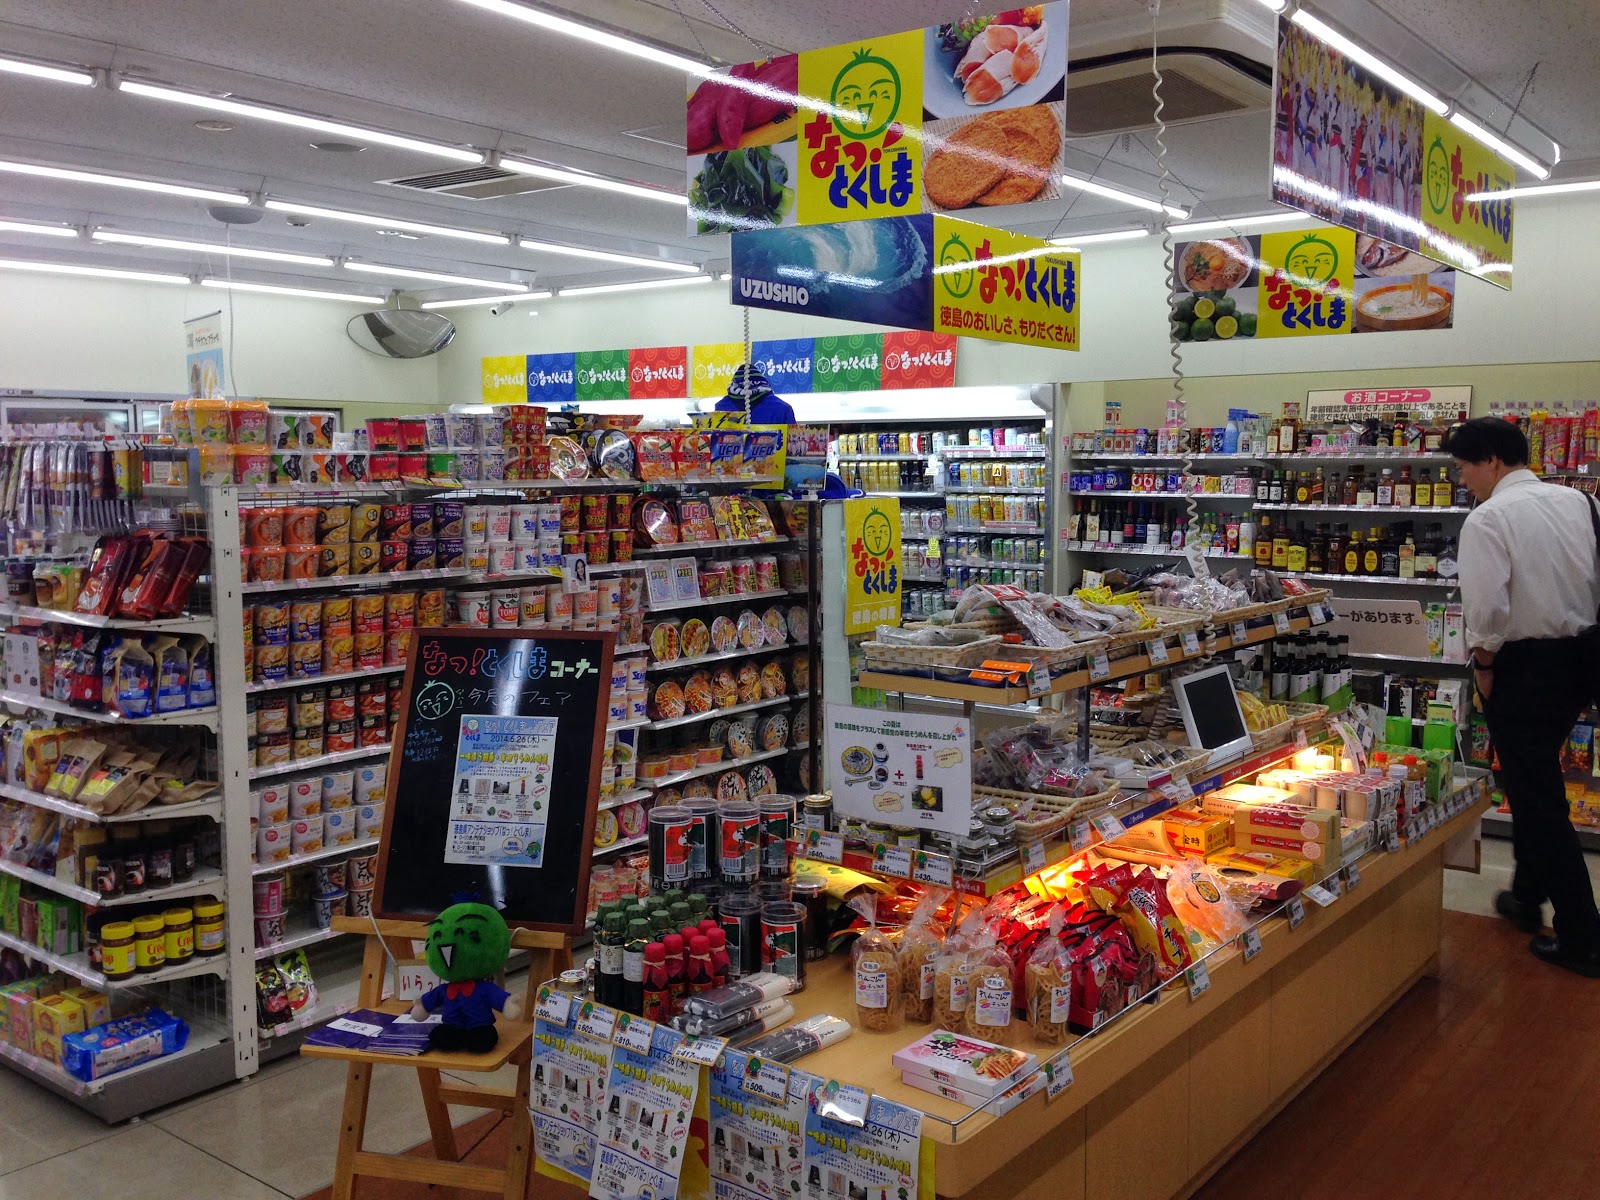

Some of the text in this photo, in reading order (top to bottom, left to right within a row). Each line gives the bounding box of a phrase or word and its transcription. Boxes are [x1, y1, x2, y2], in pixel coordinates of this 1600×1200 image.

[828, 152, 914, 210] とくしま
[740, 277, 809, 306] UZUSHIO
[1282, 296, 1346, 330] とくしま
[1351, 391, 1424, 403] お酒コーナー
[863, 564, 897, 595] とくしま
